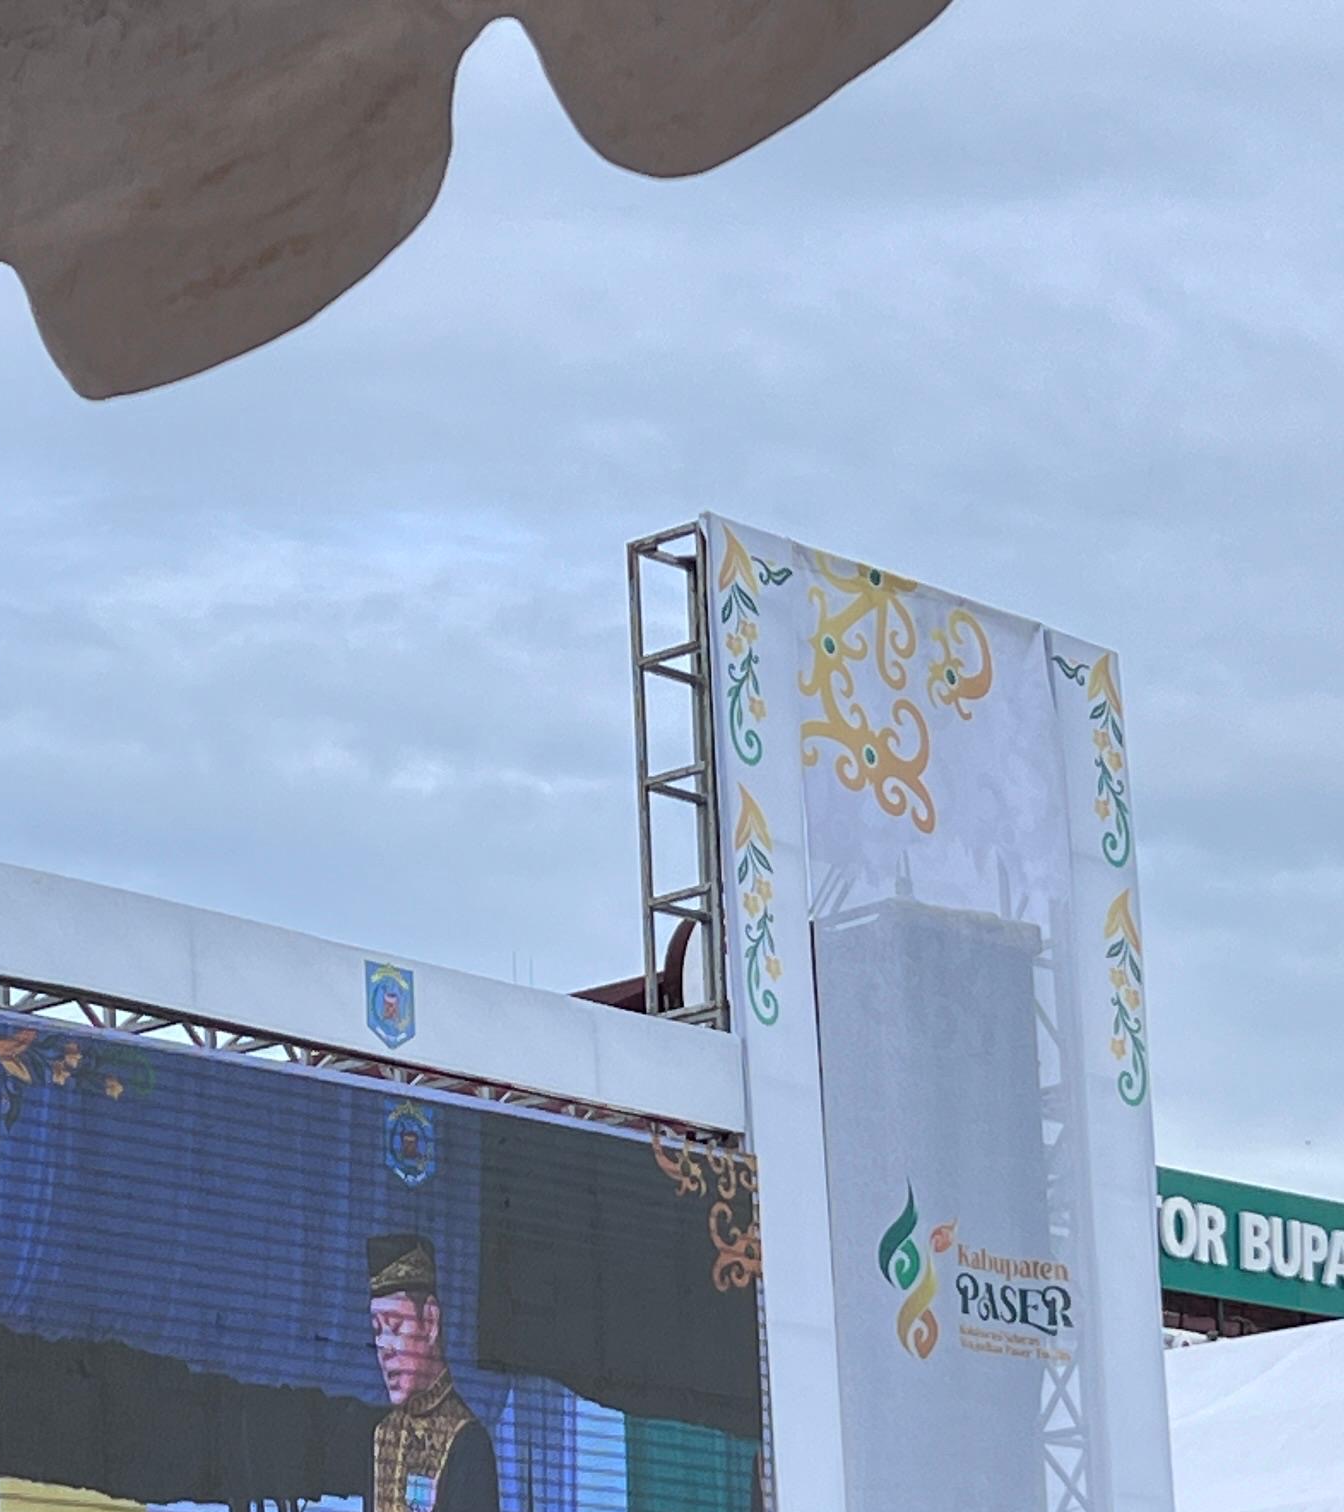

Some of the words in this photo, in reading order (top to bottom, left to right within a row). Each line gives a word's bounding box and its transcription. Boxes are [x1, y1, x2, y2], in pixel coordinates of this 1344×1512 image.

[958, 1243, 1070, 1281] Kabupaten
[1156, 1195, 1228, 1267] OR
[955, 1271, 1074, 1337] PASER
